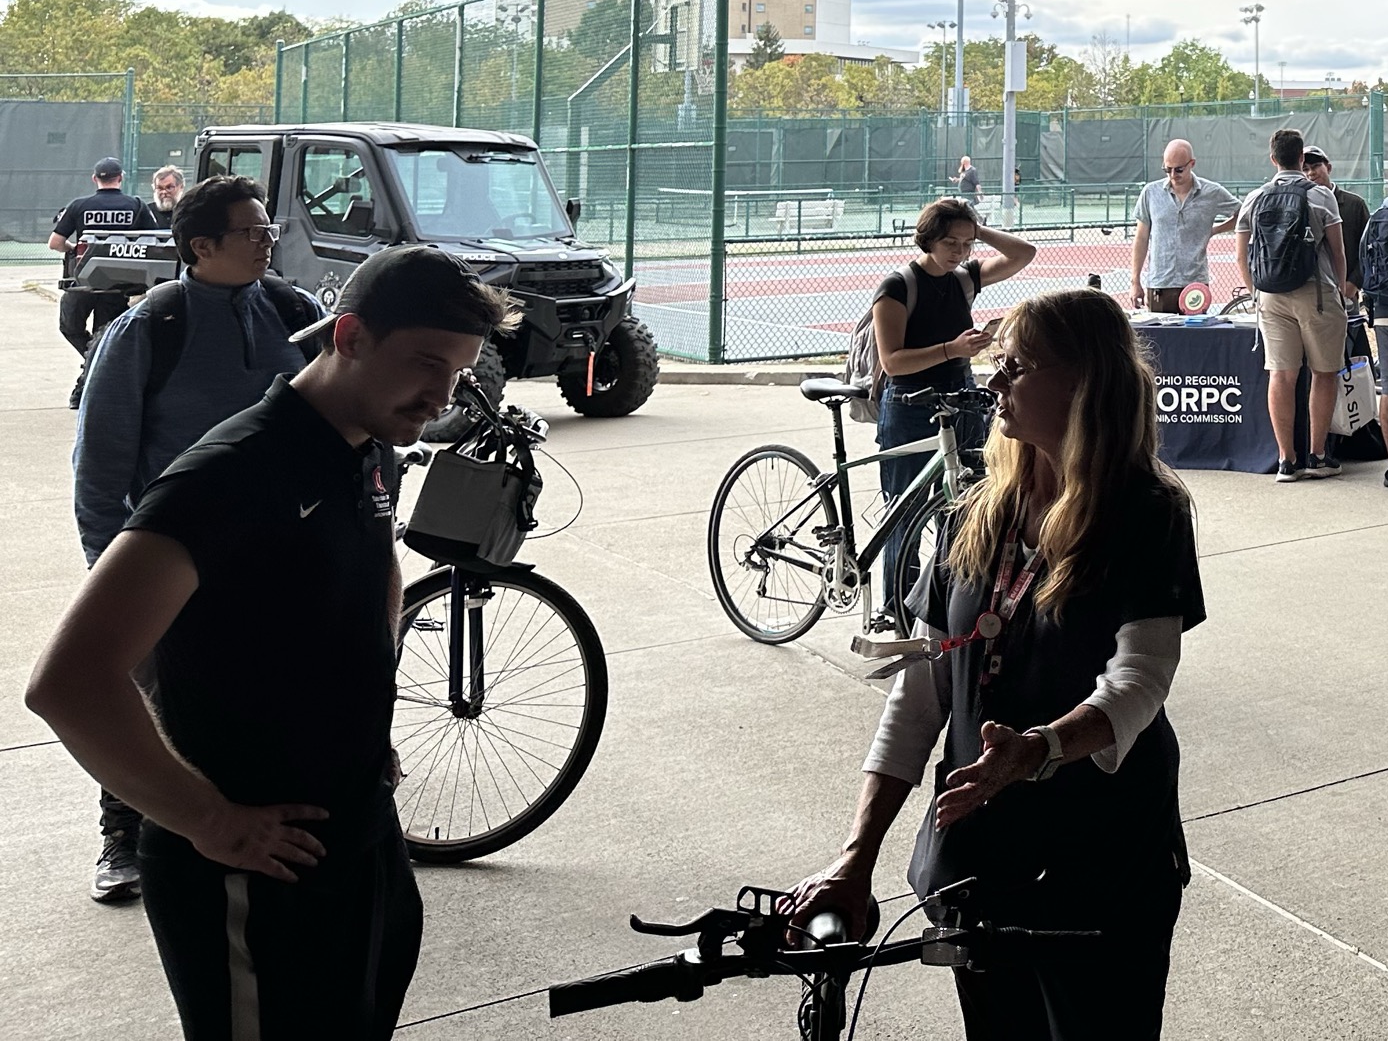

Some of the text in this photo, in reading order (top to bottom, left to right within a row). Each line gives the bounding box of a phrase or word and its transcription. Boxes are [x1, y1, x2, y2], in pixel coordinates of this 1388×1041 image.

[85, 212, 132, 224] POLICE
[109, 244, 147, 258] POLICE
[462, 253, 497, 261] POLICE
[1154, 375, 1241, 386] OHIO REGIONAL
[1156, 387, 1242, 413] ORPC
[1180, 414, 1242, 424] COMMISSION
